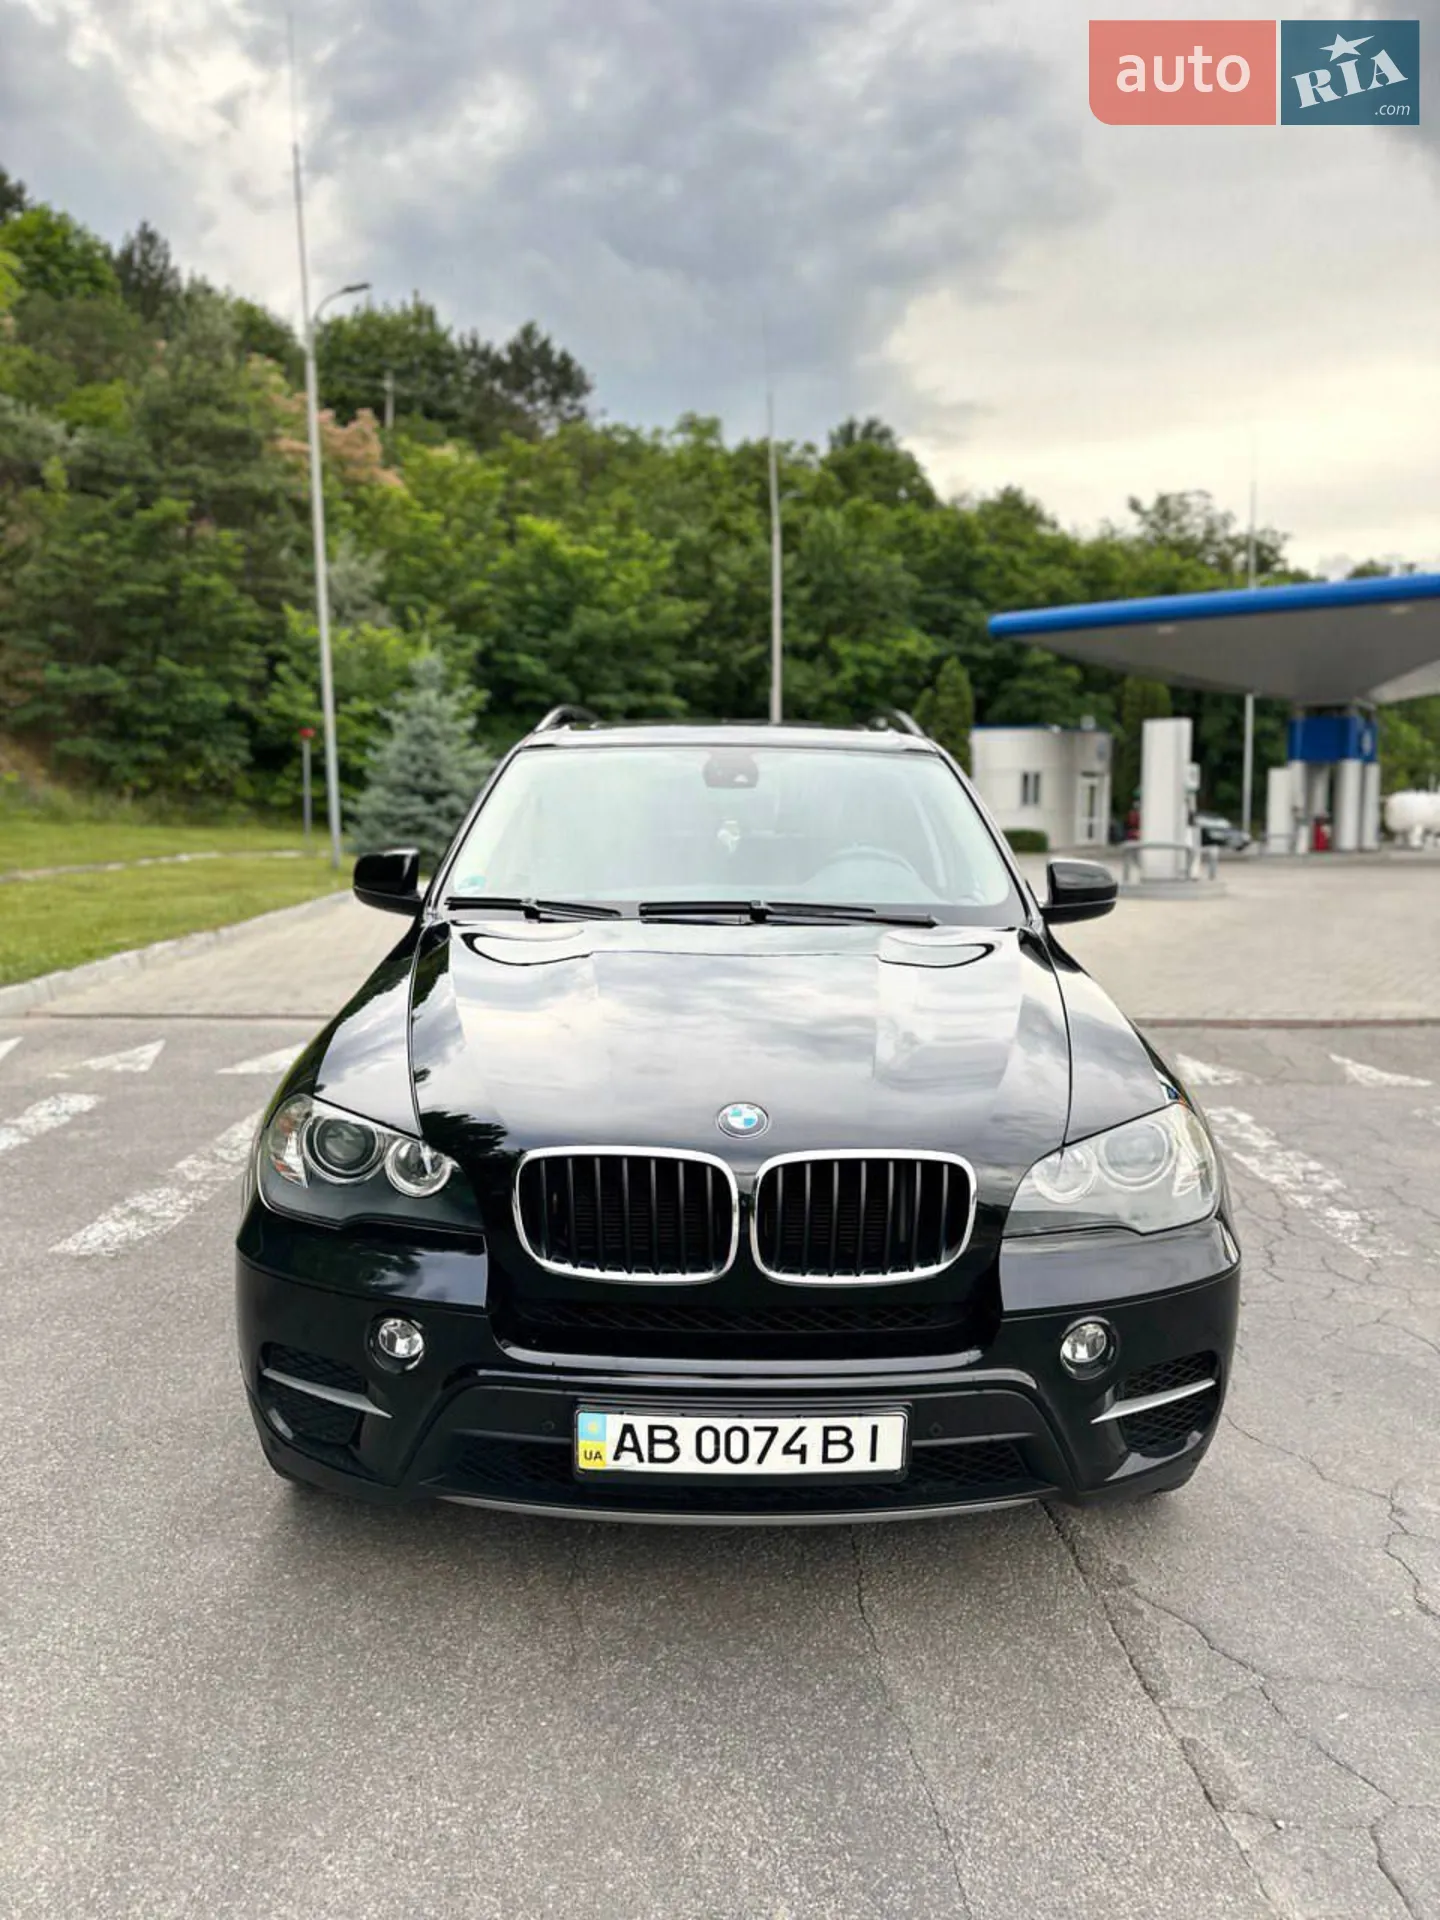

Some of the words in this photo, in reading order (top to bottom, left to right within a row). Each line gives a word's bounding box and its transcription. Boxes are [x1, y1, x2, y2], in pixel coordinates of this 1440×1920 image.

[583, 1451, 603, 1462] UA
[612, 1423, 679, 1465] AB
[695, 1425, 807, 1465] 0074
[821, 1425, 879, 1465] BI
